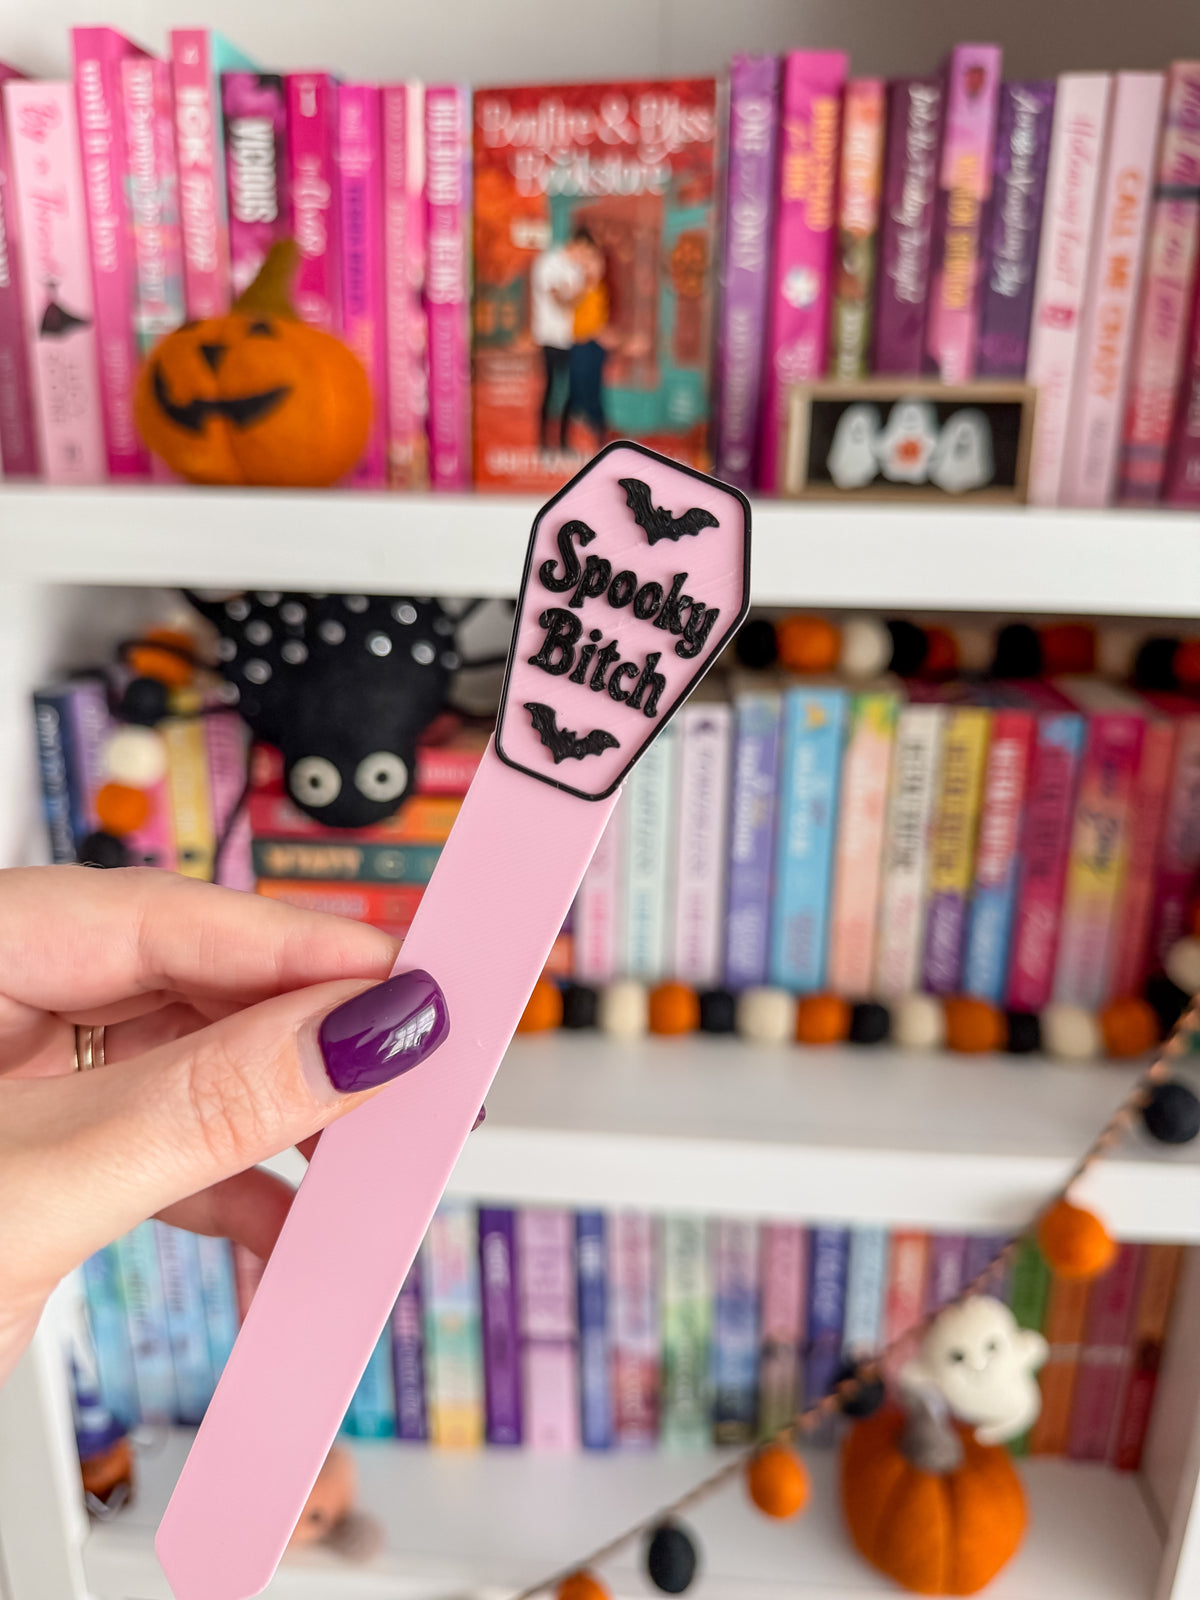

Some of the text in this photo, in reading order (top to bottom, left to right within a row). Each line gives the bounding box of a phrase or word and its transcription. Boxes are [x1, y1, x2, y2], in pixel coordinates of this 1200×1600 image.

[230, 118, 278, 222] VICIOUS
[539, 520, 720, 659] Spooky
[528, 608, 666, 718] Bitch
